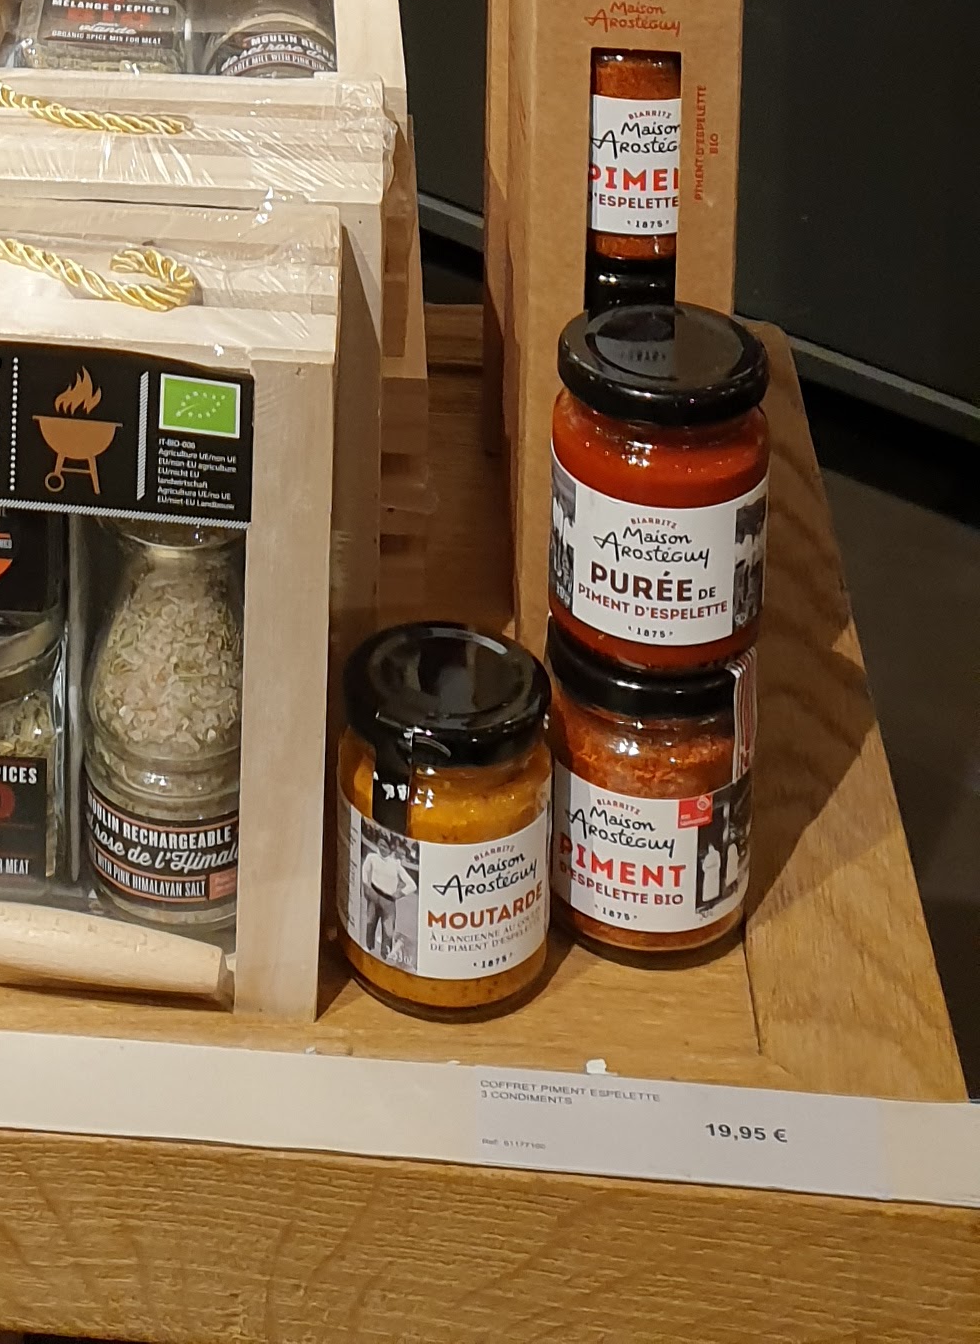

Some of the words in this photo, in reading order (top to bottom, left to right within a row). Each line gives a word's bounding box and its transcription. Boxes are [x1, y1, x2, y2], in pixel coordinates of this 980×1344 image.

[610, 2, 665, 14] Maison
[628, 110, 672, 120] BIARRITZ
[631, 517, 677, 528] BIARRITZ
[623, 527, 692, 545] Maison
[591, 561, 693, 601] PURÉE
[698, 586, 716, 600] DE
[578, 582, 631, 612] PIMENT
[635, 600, 728, 621] D'ESPELETTE
[637, 628, 665, 639] 1875
[597, 799, 641, 815] BIARRITZ
[590, 806, 656, 832] Maison
[123, 822, 232, 850] RECHARGEABLE
[474, 845, 515, 862] BIARRITZ
[559, 832, 686, 887] PIMENT
[5, 858, 30, 875] MEAT
[466, 853, 525, 879] Maison
[132, 874, 182, 896] HIMALAYAN
[185, 881, 205, 896] SALT
[428, 880, 542, 929] MOUTARDE
[654, 894, 683, 905] BIO
[603, 907, 630, 921] 1875
[482, 956, 507, 969] 1875
[480, 1080, 538, 1092] COFFRET
[541, 1084, 586, 1095] PIMENT
[590, 1089, 660, 1102] ESPELETTE
[481, 1090, 487, 1098] 3
[491, 1091, 572, 1105] CONDIMENTS
[705, 1123, 766, 1142] 19,95
[773, 1128, 788, 1143] €
